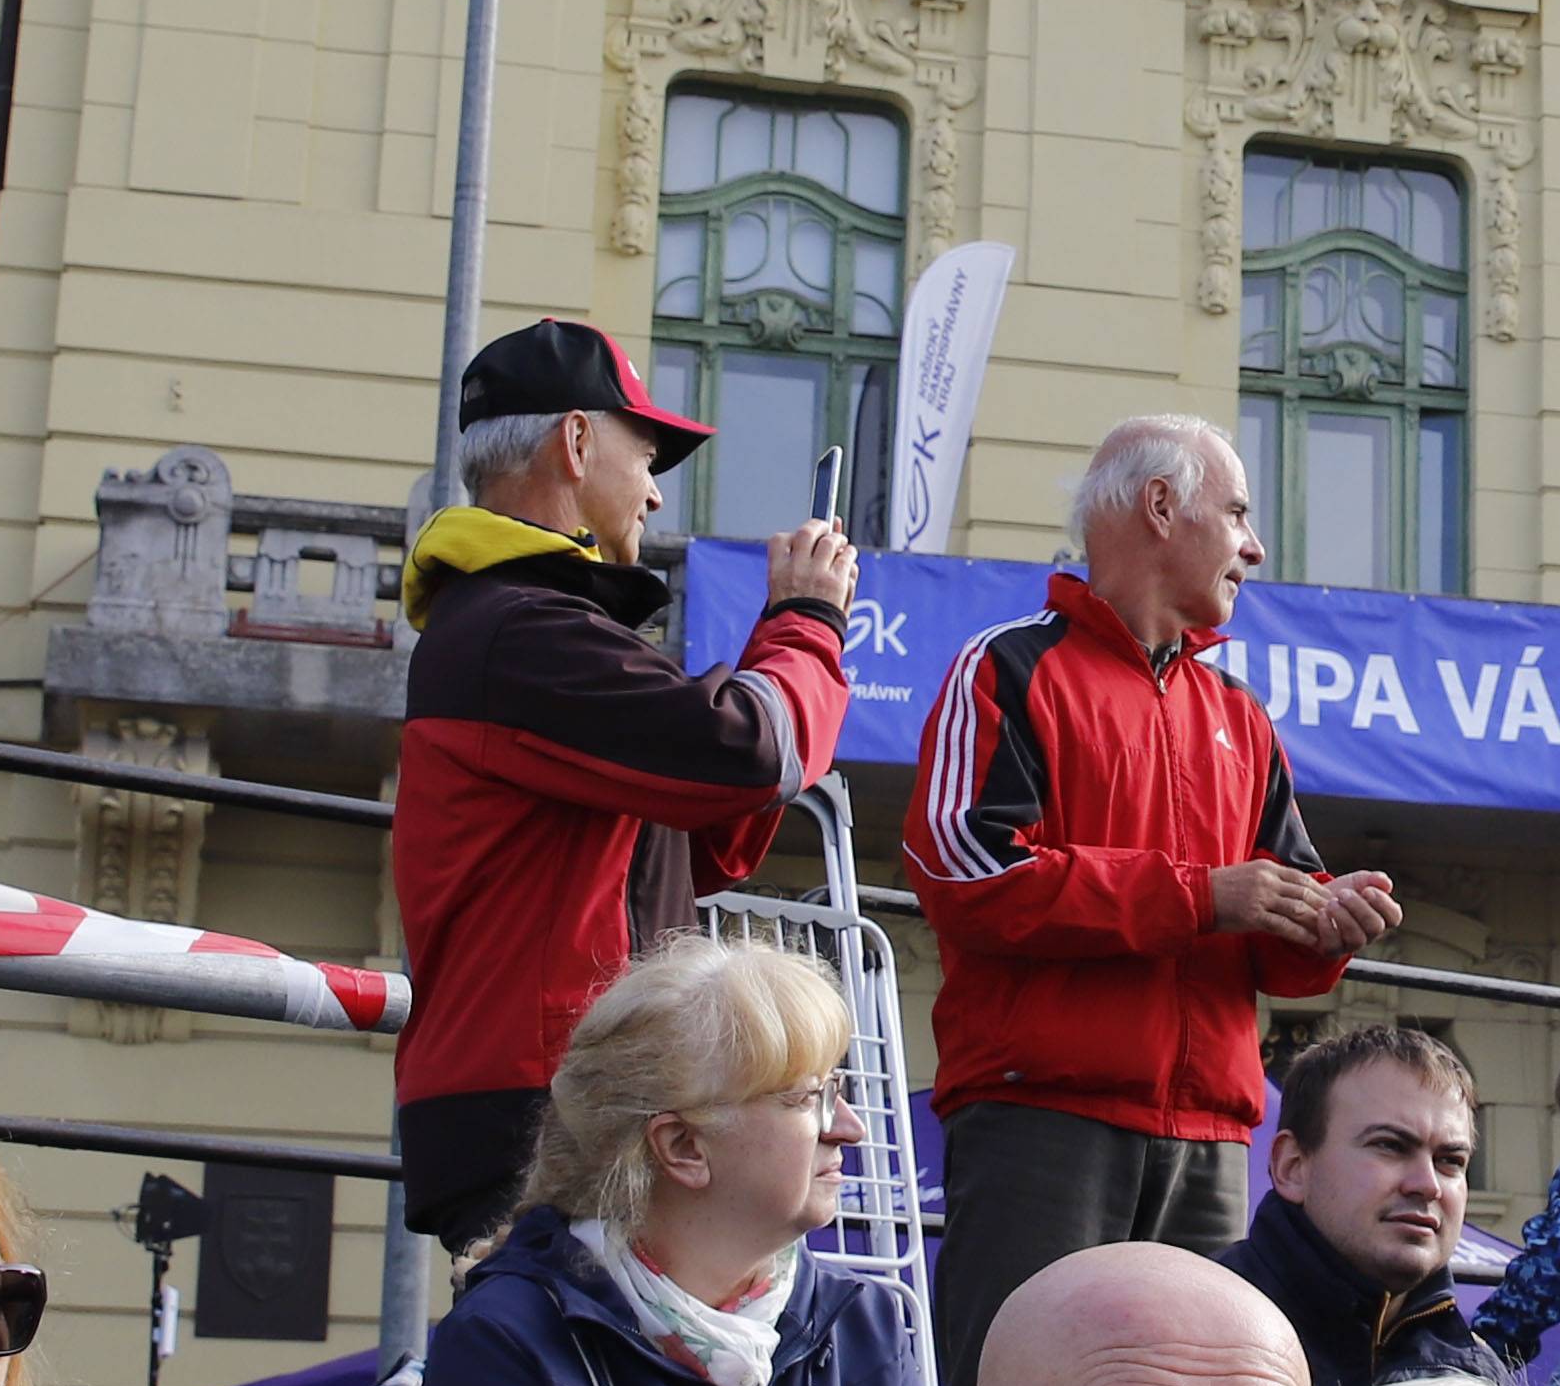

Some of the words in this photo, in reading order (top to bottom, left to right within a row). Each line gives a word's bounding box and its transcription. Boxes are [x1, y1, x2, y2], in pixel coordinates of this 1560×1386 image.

[918, 317, 941, 400] KOŠICKÝ
[927, 267, 969, 407] SAMOSPRÁVNY
[935, 363, 957, 414] KRAJ
[1212, 639, 1420, 734] UPA
